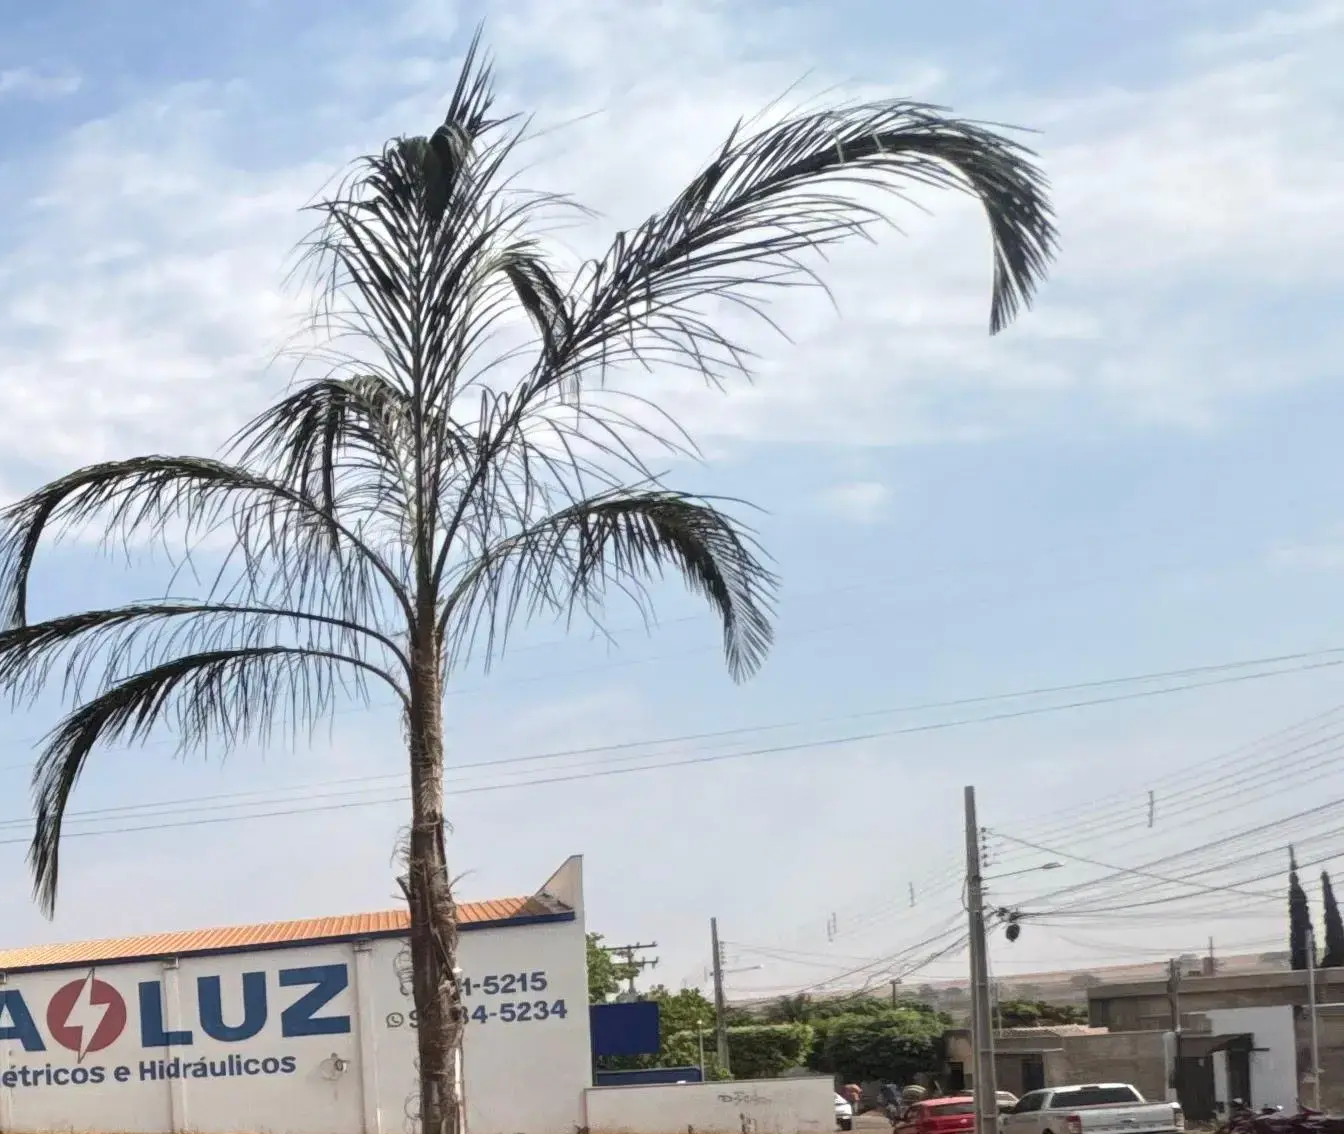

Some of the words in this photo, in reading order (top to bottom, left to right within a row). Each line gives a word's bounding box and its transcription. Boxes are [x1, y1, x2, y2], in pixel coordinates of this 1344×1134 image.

[138, 963, 351, 1048] LUZ
[114, 1065, 131, 1082] e
[139, 1054, 297, 1081] Hidráulicos
